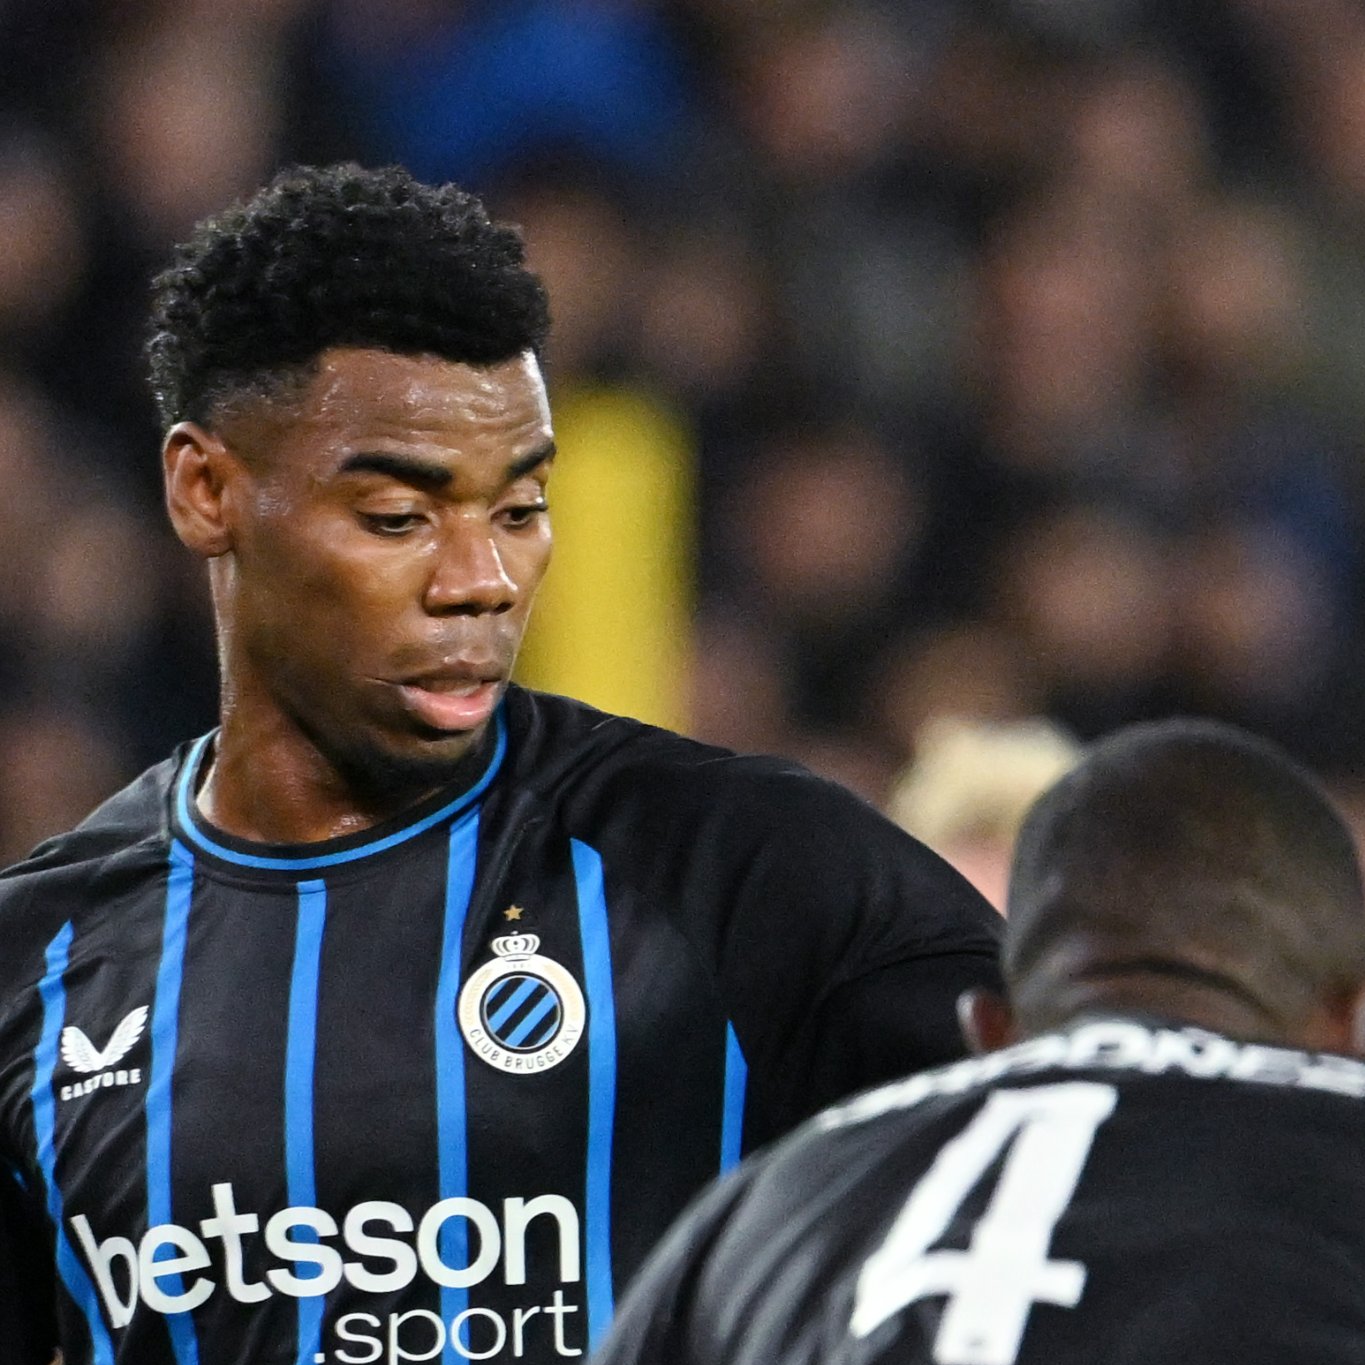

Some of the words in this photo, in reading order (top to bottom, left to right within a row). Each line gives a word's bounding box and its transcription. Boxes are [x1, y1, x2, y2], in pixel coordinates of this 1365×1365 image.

[469, 1027, 500, 1061] CLUB
[504, 1046, 564, 1070] BRUGGE
[71, 1182, 581, 1329] betsson
